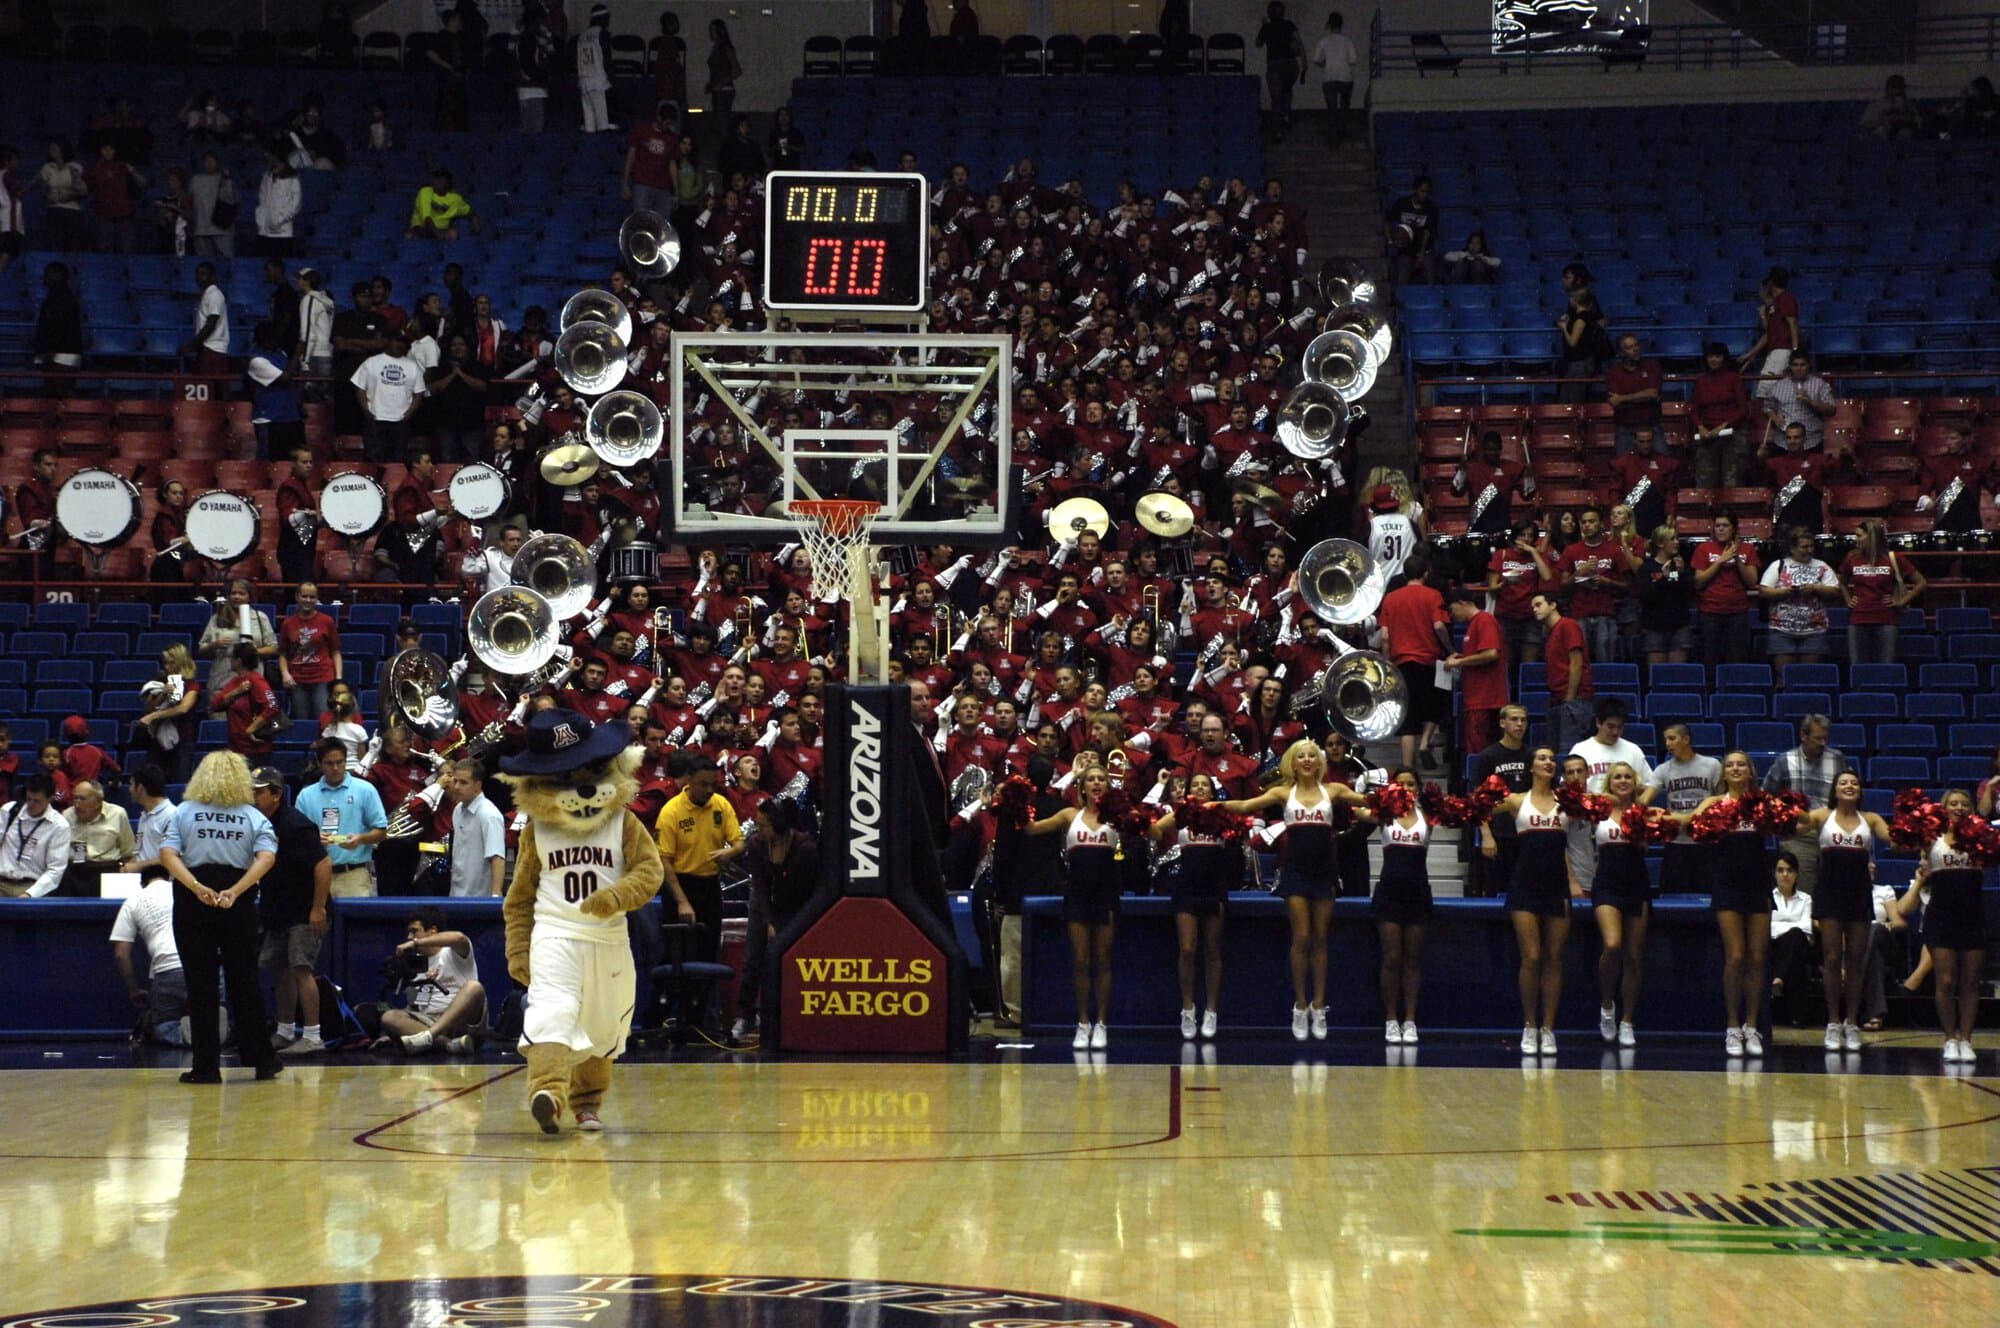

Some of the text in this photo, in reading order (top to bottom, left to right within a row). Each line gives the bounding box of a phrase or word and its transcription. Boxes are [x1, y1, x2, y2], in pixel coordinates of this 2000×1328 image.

[786, 187, 878, 222] 00.0
[804, 239, 886, 295] 00
[184, 384, 208, 400] 20
[83, 481, 116, 489] YAMAHA
[340, 483, 367, 491] YAMAHA
[465, 473, 492, 483] YAMAHA
[209, 502, 242, 512] YAMAHA
[1384, 535, 1402, 560] 31
[553, 723, 579, 749] A
[849, 700, 881, 878] ARIZONA
[1667, 776, 1709, 792] ARIZONA
[194, 811, 246, 825] EVENT
[197, 828, 245, 841] STAFF
[548, 847, 614, 871] ARIZONA
[564, 871, 598, 904] 00
[796, 958, 932, 984] WELLS
[800, 990, 930, 1016] FARGO
[557, 1277, 1062, 1315] LUTE
